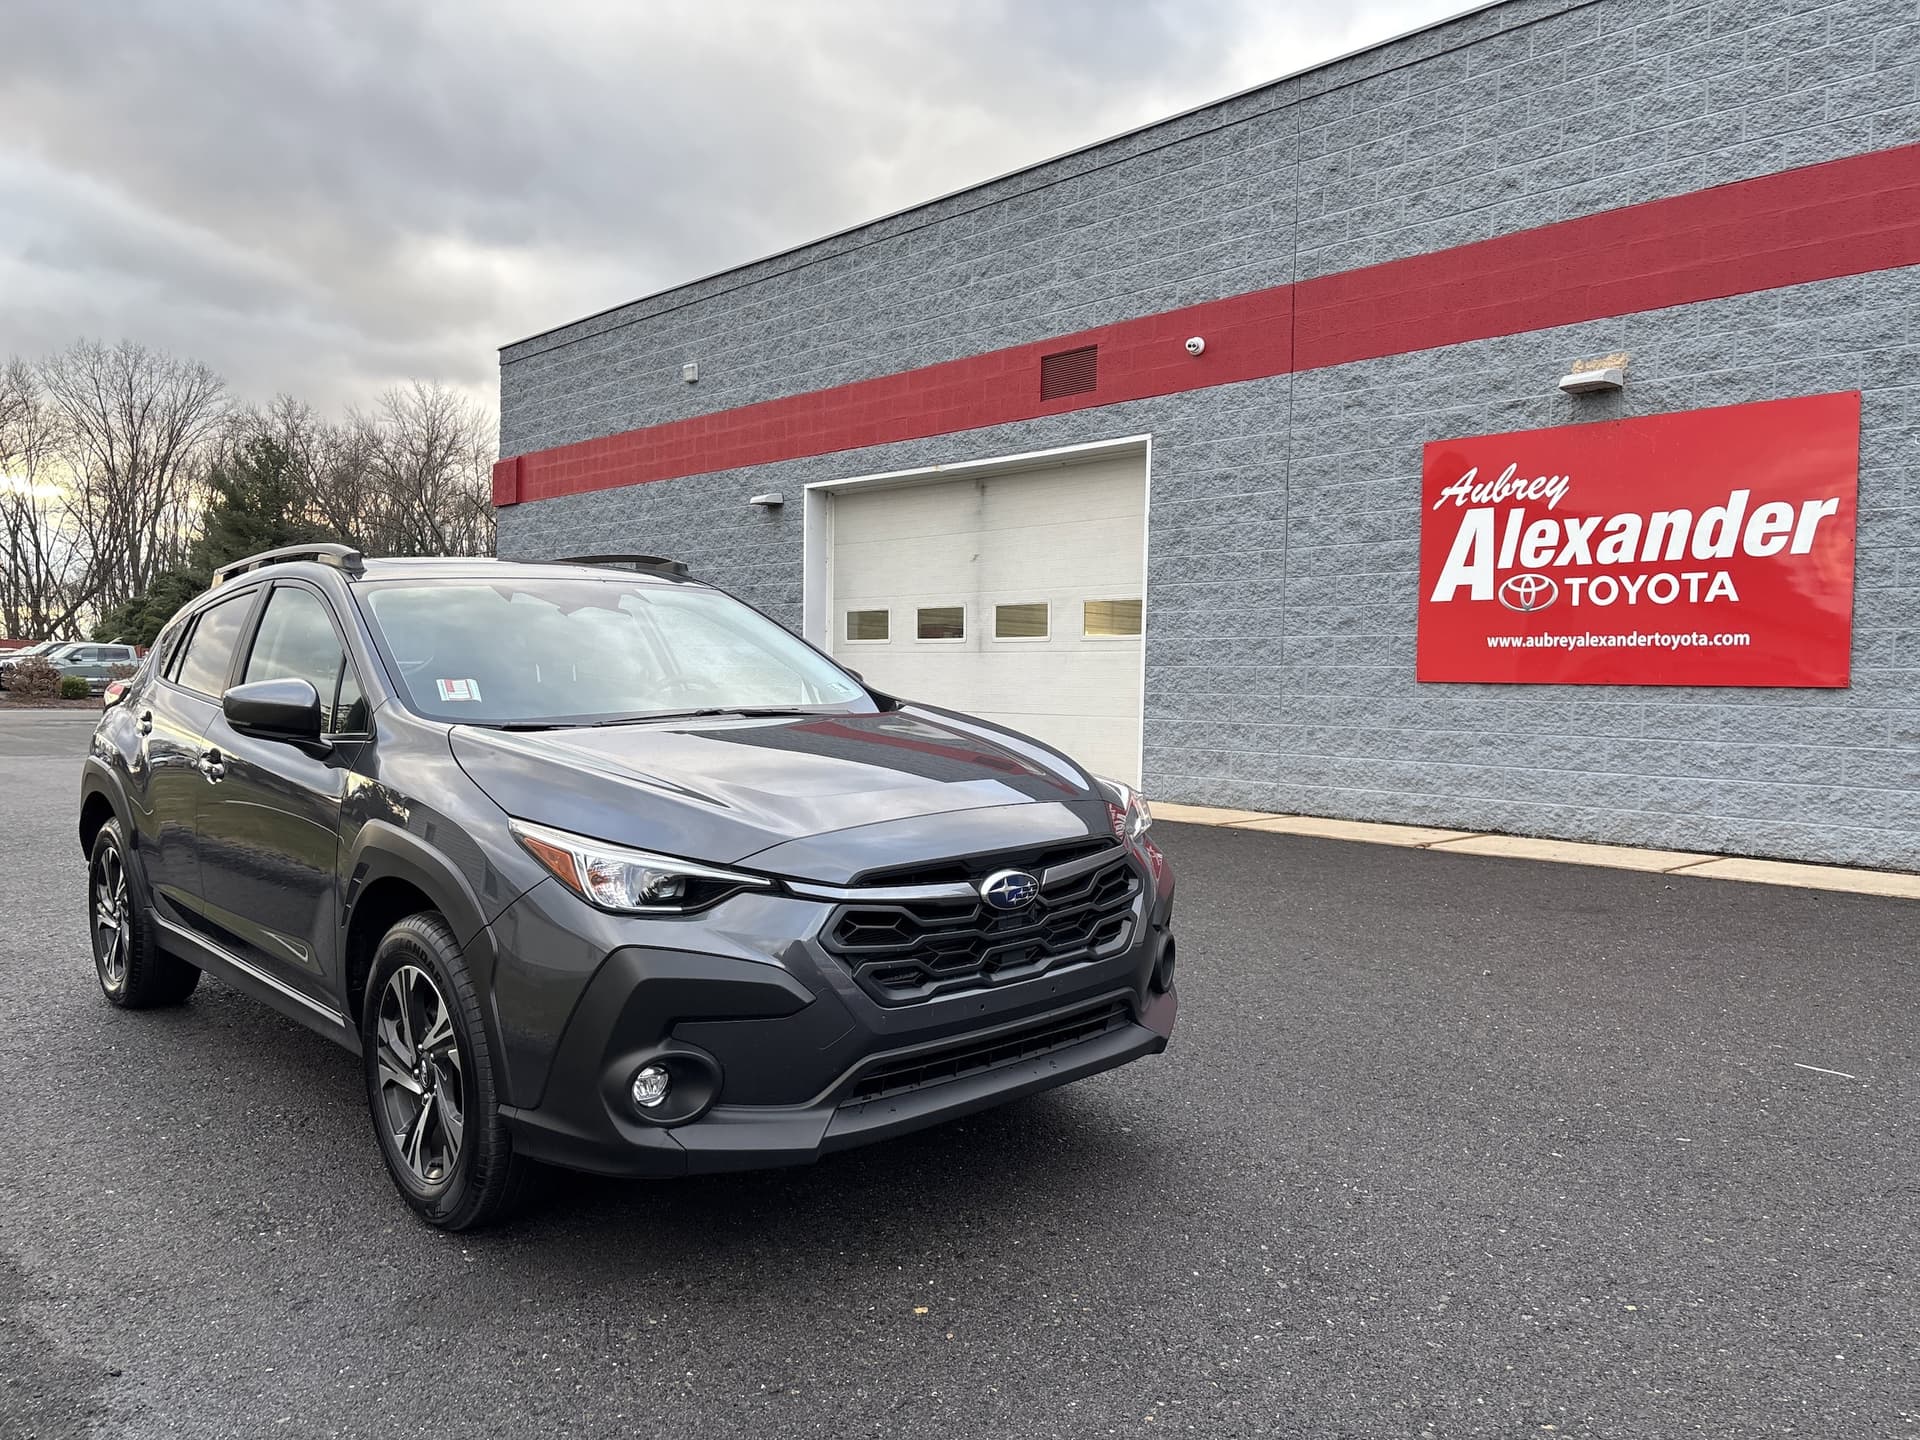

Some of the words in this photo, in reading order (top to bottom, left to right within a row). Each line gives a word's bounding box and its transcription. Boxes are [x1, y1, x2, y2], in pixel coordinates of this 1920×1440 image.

[1433, 462, 1570, 511] Aubrey
[1430, 489, 1840, 602] Alexander
[1564, 571, 1739, 607] TOYOTA
[1487, 631, 1750, 651] www.aubreyalexandertoyota.com
